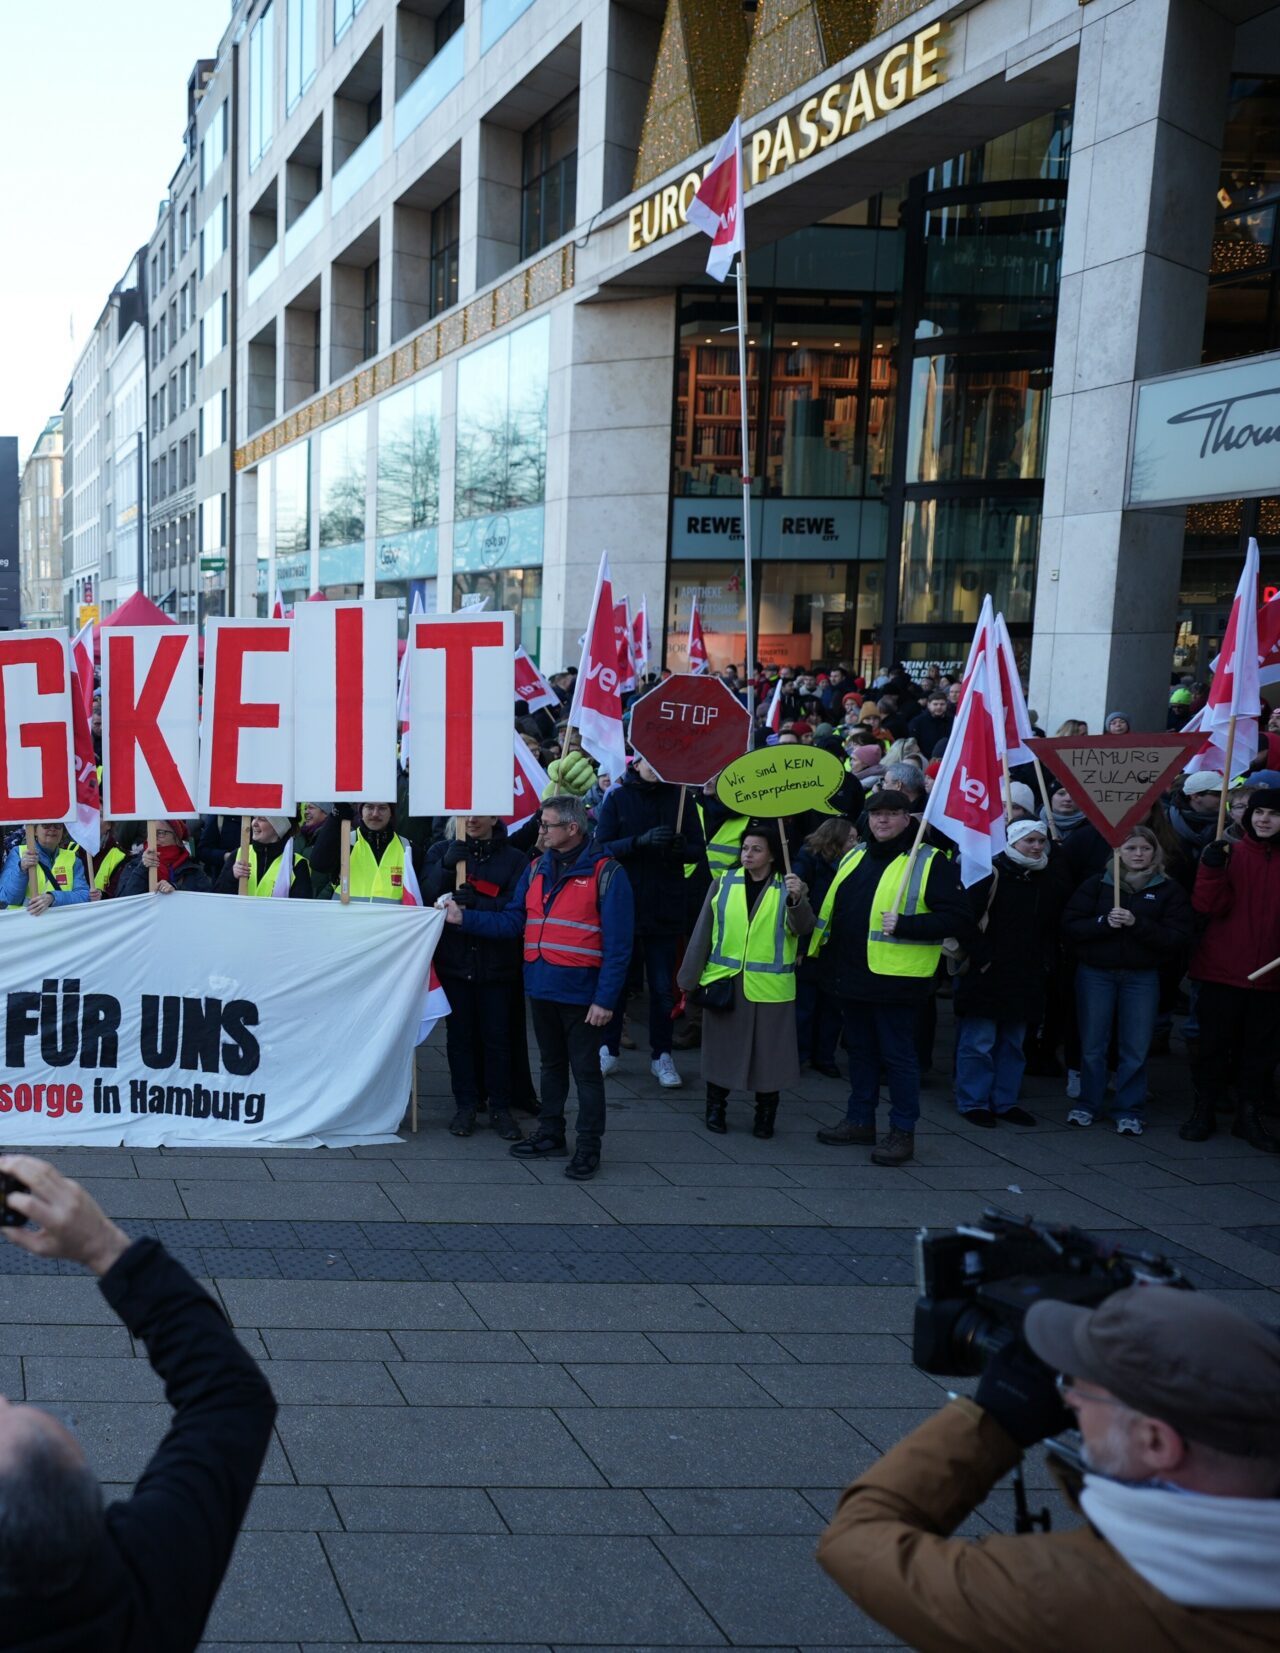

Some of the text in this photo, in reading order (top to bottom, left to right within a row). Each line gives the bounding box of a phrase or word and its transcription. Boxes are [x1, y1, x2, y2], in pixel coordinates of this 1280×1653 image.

[628, 22, 942, 252] EURO PASSAGE
[687, 517, 741, 534] REWE
[782, 518, 835, 534] REWE
[681, 586, 722, 598] APOTHEKE
[660, 701, 719, 726] STOP
[725, 758, 814, 787] Wir sind KEIN
[1082, 770, 1160, 784] ZULAGE
[735, 775, 824, 803] Einsparpotenzial
[1094, 789, 1144, 803] JETZT
[5, 978, 122, 1069] FÜR
[140, 994, 261, 1075] UNS
[93, 1078, 122, 1115] in
[129, 1079, 266, 1125] Hamburg
